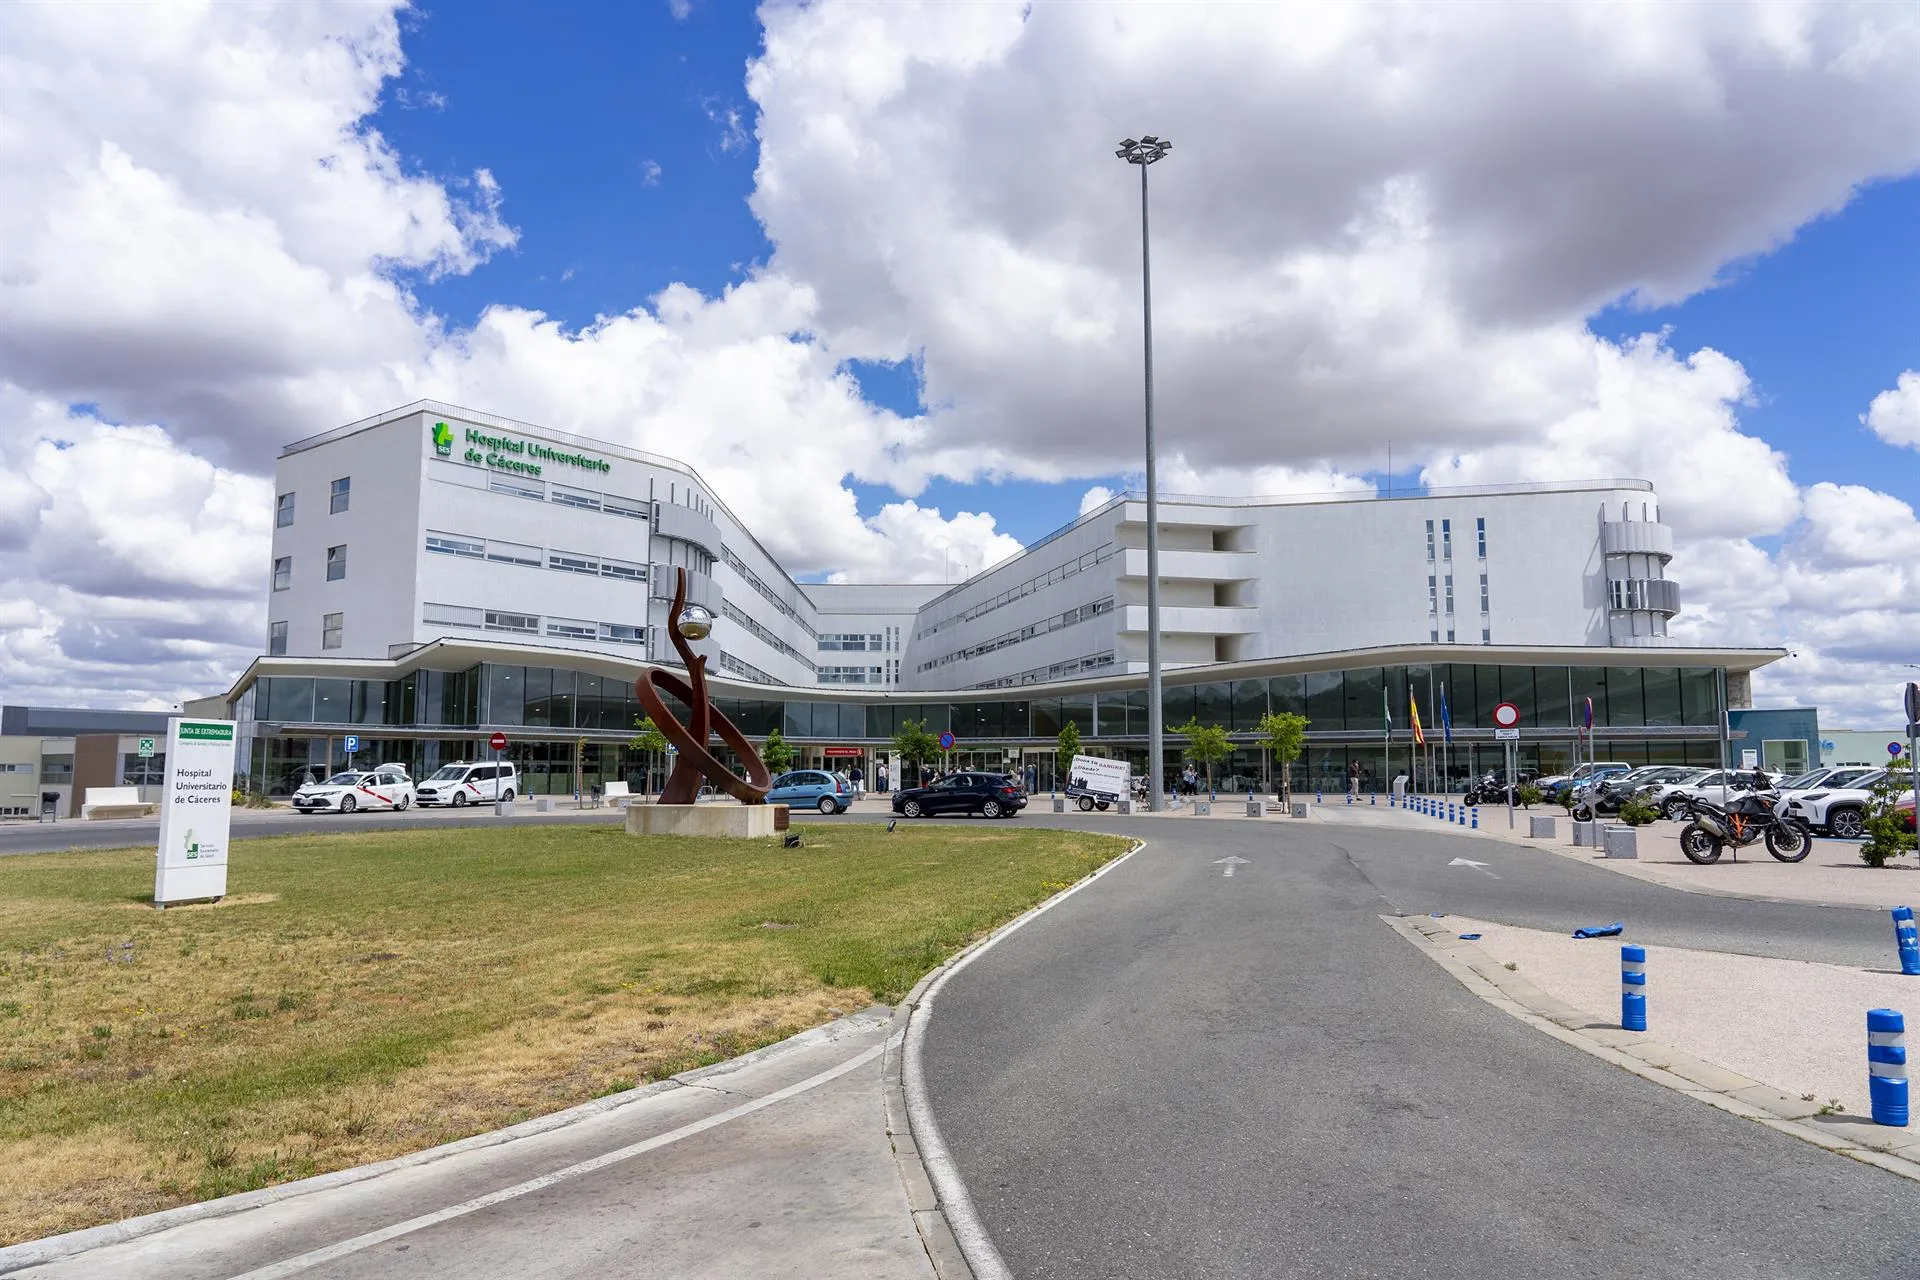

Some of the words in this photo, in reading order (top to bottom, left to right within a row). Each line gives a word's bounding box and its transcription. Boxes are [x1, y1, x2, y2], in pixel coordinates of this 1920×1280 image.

[438, 445, 450, 454] SES
[466, 428, 525, 453] Hospital
[528, 443, 611, 473] Universitario
[464, 448, 483, 464] de
[486, 451, 542, 476] Cáceres
[180, 727, 194, 735] JUNTA
[194, 727, 201, 735] DE
[201, 728, 232, 736] EXTREMADURA
[348, 737, 356, 750] P
[177, 768, 212, 779] Hospital
[176, 782, 228, 791] Universitario
[174, 795, 185, 804] de
[187, 794, 221, 804] Cáceres
